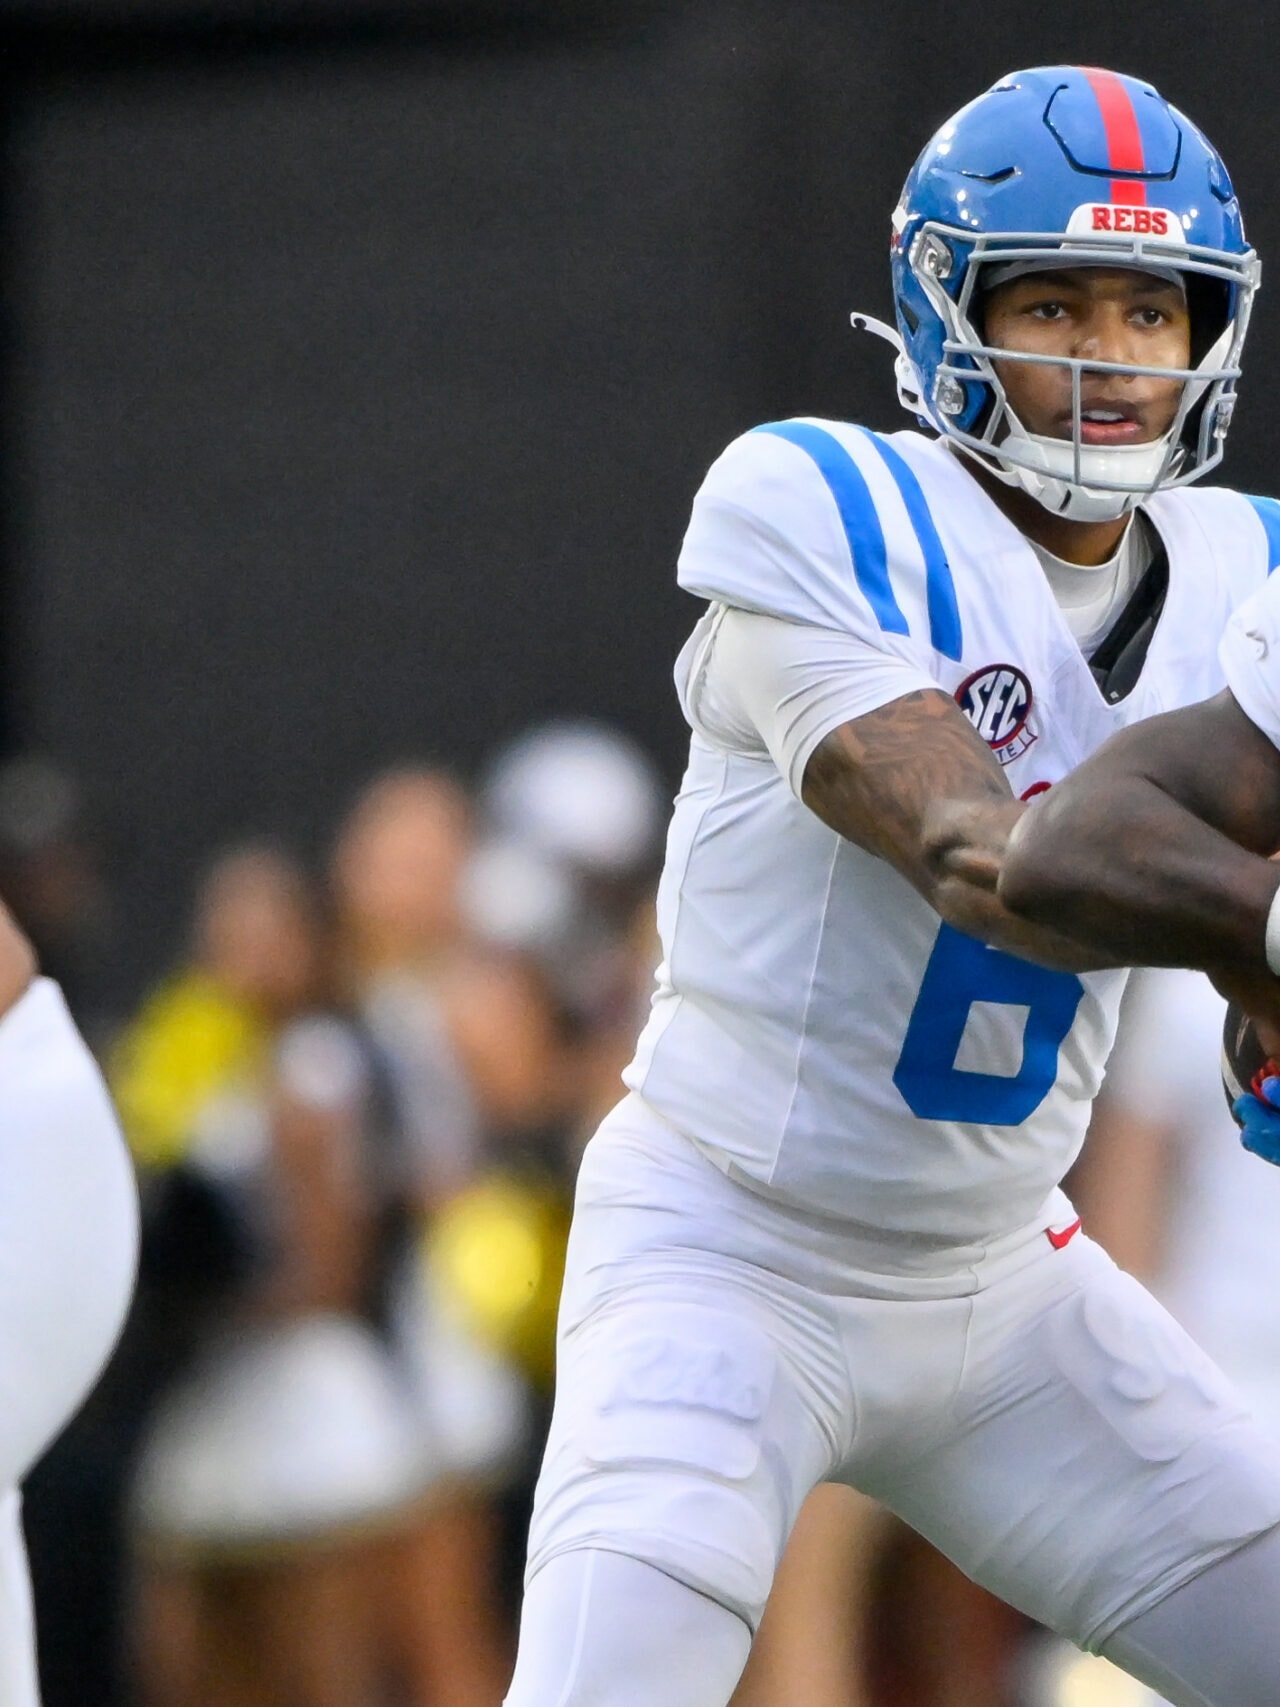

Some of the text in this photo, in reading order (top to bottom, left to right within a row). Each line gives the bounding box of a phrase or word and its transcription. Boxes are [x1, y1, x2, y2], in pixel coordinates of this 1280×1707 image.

[1092, 207, 1168, 235] REBS
[962, 669, 1027, 742] SEC
[892, 918, 1085, 1127] 6
